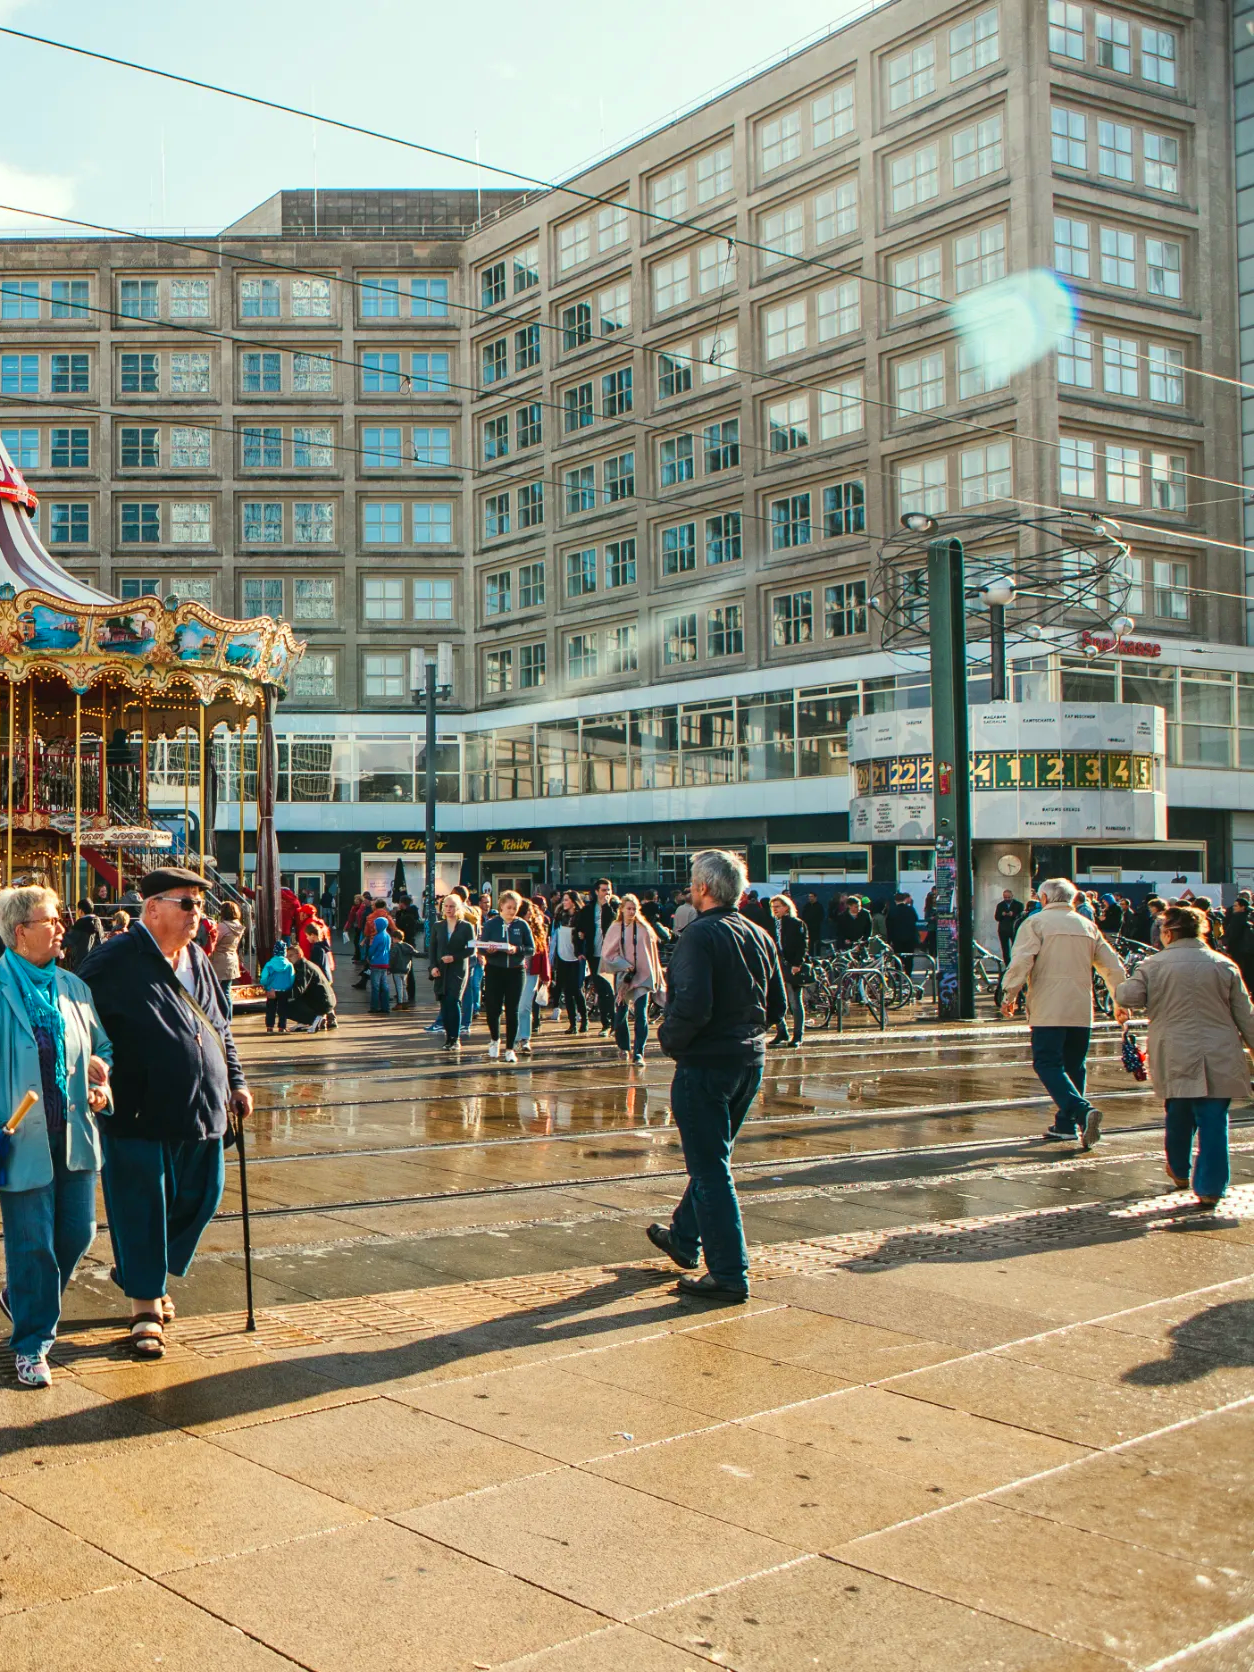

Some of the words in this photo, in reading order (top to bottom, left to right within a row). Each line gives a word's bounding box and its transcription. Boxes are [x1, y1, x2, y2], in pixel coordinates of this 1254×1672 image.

[872, 763, 886, 787] 21
[890, 762, 916, 785] 22
[920, 761, 933, 784] 2
[970, 759, 991, 781] 4
[1007, 759, 1021, 781] 1
[1046, 758, 1065, 781] 2
[1085, 759, 1100, 780] 3
[1115, 760, 1129, 782] 4
[1139, 761, 1149, 780] 5
[401, 839, 447, 850] Tcho
[501, 838, 532, 850] Tchibo
